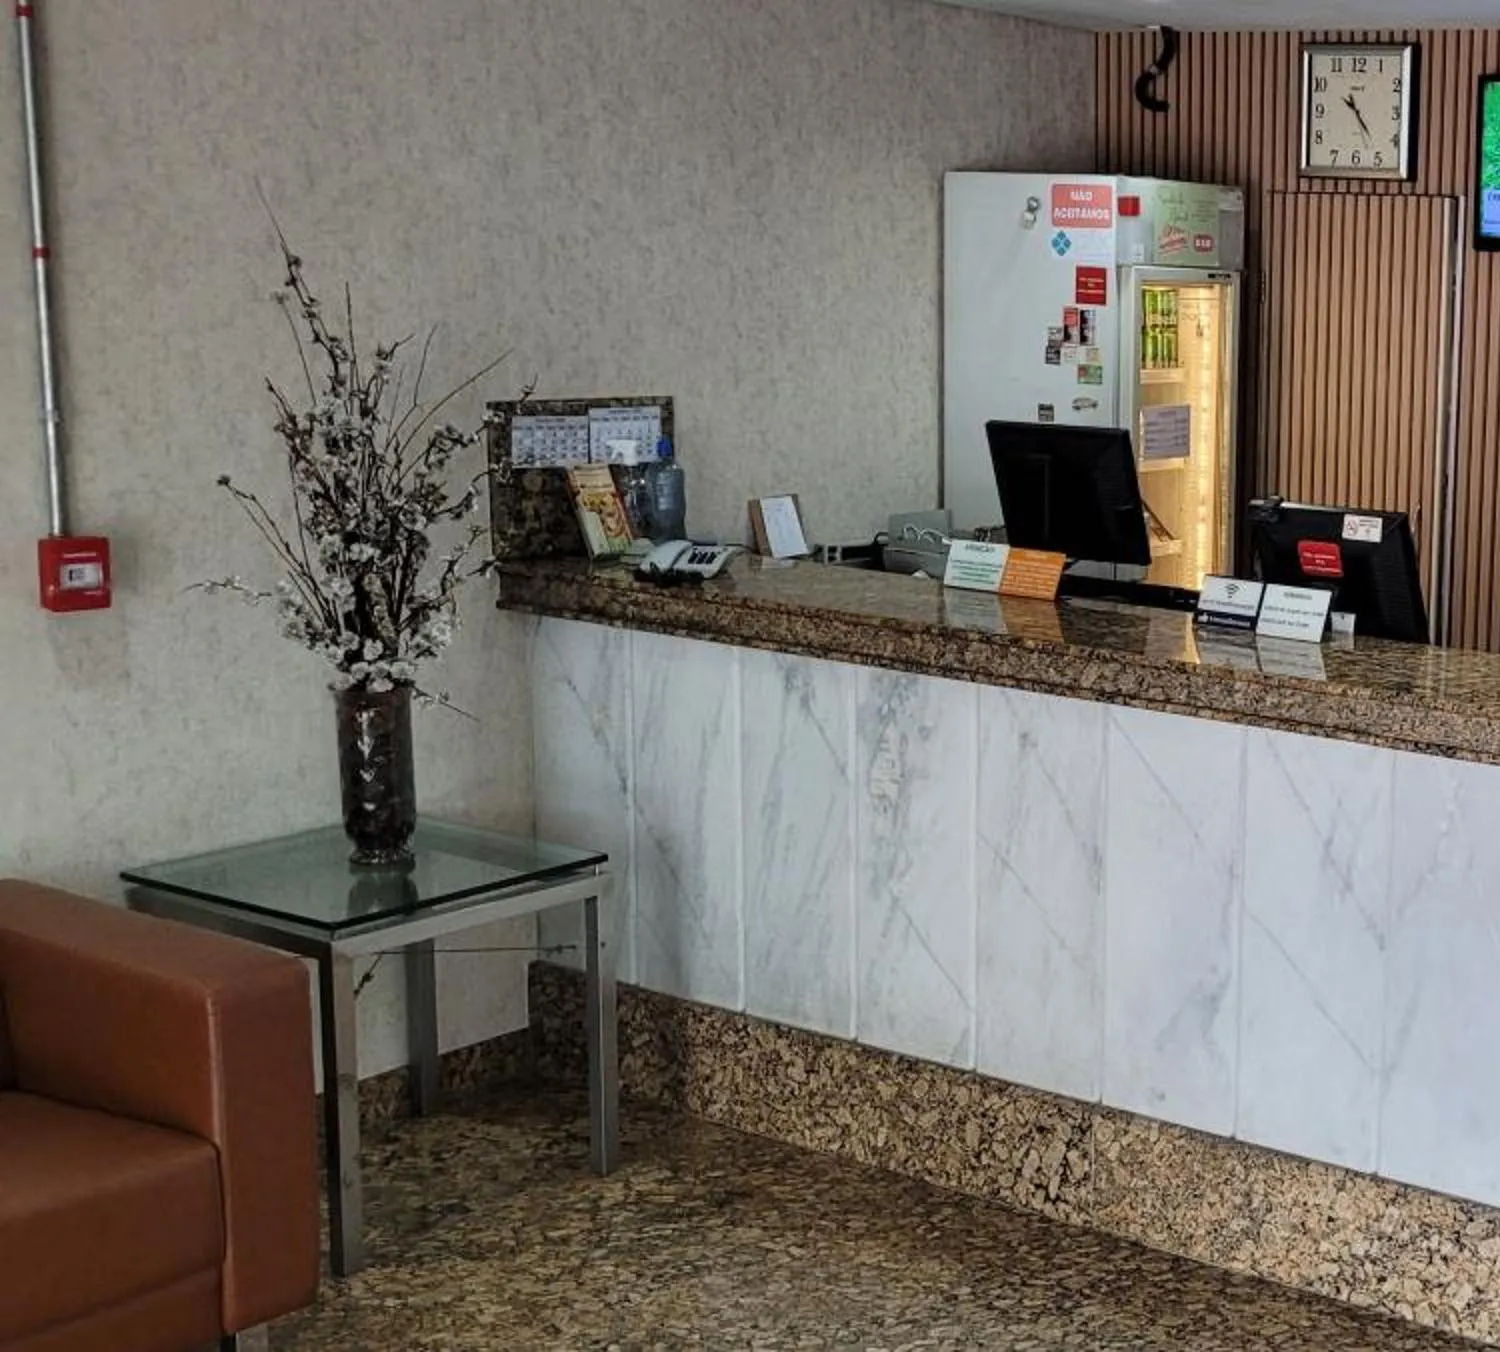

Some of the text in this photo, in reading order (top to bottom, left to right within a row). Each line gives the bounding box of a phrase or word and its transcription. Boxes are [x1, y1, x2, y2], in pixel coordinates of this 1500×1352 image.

[1330, 57, 1342, 73] 11
[1351, 57, 1367, 73] 12
[1314, 75, 1328, 92] 10
[1392, 77, 1401, 93] 2
[1315, 103, 1325, 118] 9
[1391, 105, 1400, 121] 3
[1315, 129, 1323, 145] 8
[1329, 149, 1339, 168] 7
[1351, 150, 1361, 165] 6
[1373, 151, 1383, 167] 5
